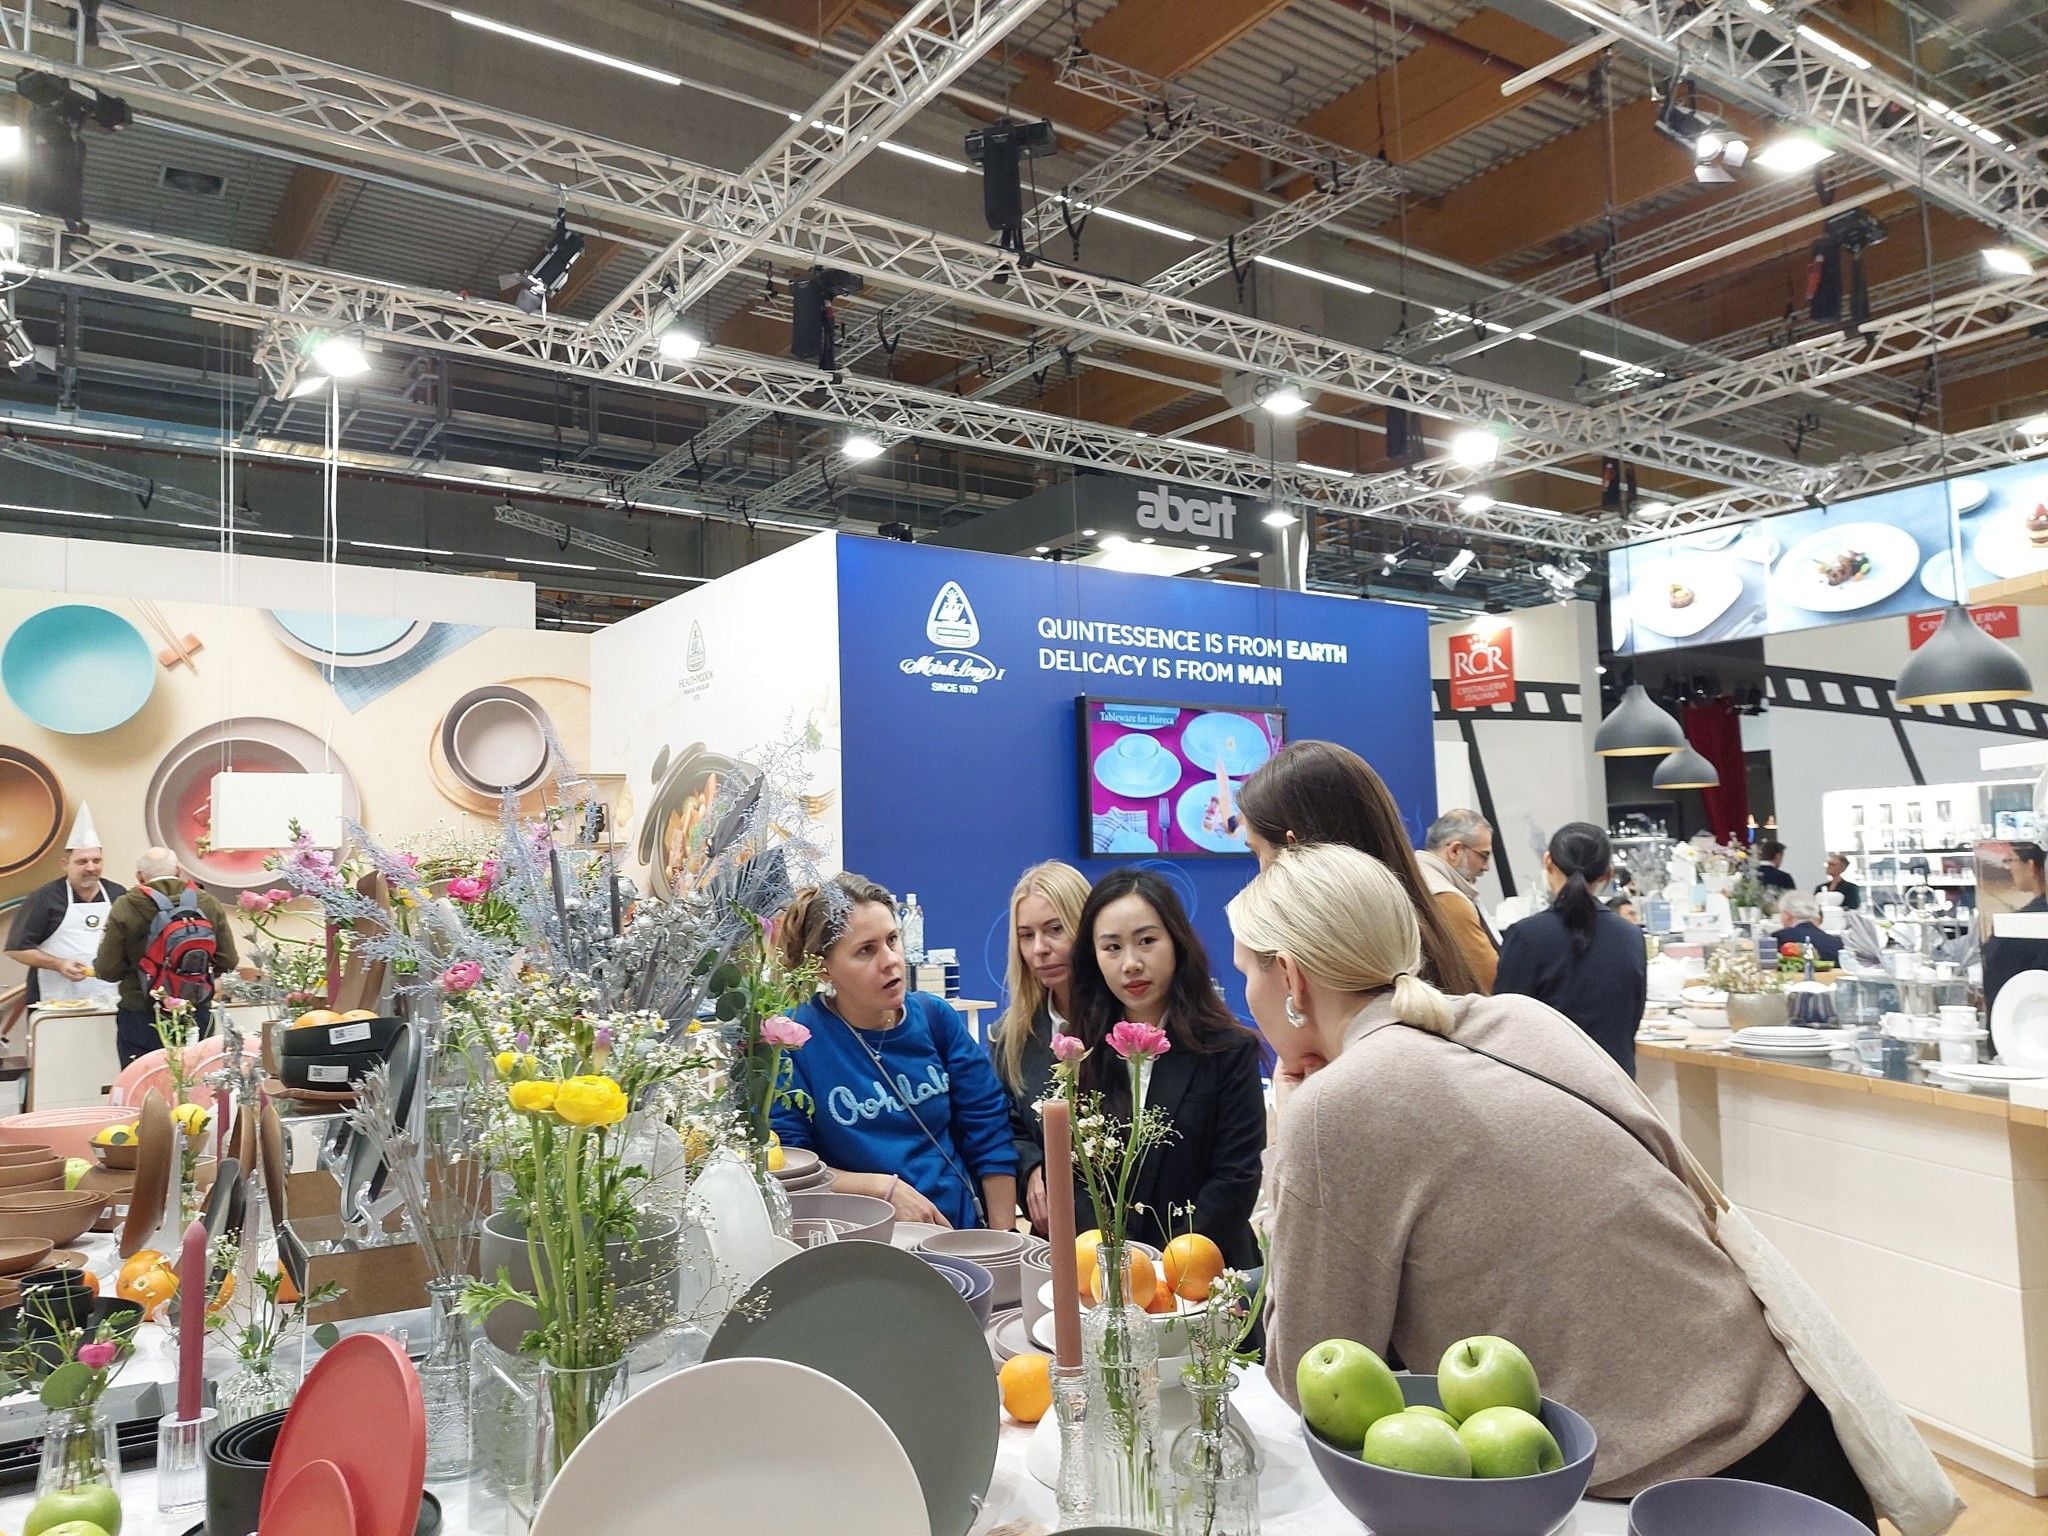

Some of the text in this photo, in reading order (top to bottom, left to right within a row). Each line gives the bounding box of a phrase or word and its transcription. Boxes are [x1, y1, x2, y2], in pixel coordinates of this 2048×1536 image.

[1136, 484, 1237, 540] abert
[1037, 616, 1348, 664] QUINTESSENCE IS FROM EARTH
[1039, 647, 1283, 687] DELICACY IS FROM MAN
[1453, 645, 1510, 678] RCR
[931, 682, 979, 695] SINCE 1970
[1100, 711, 1175, 725] Tableware for Horeca
